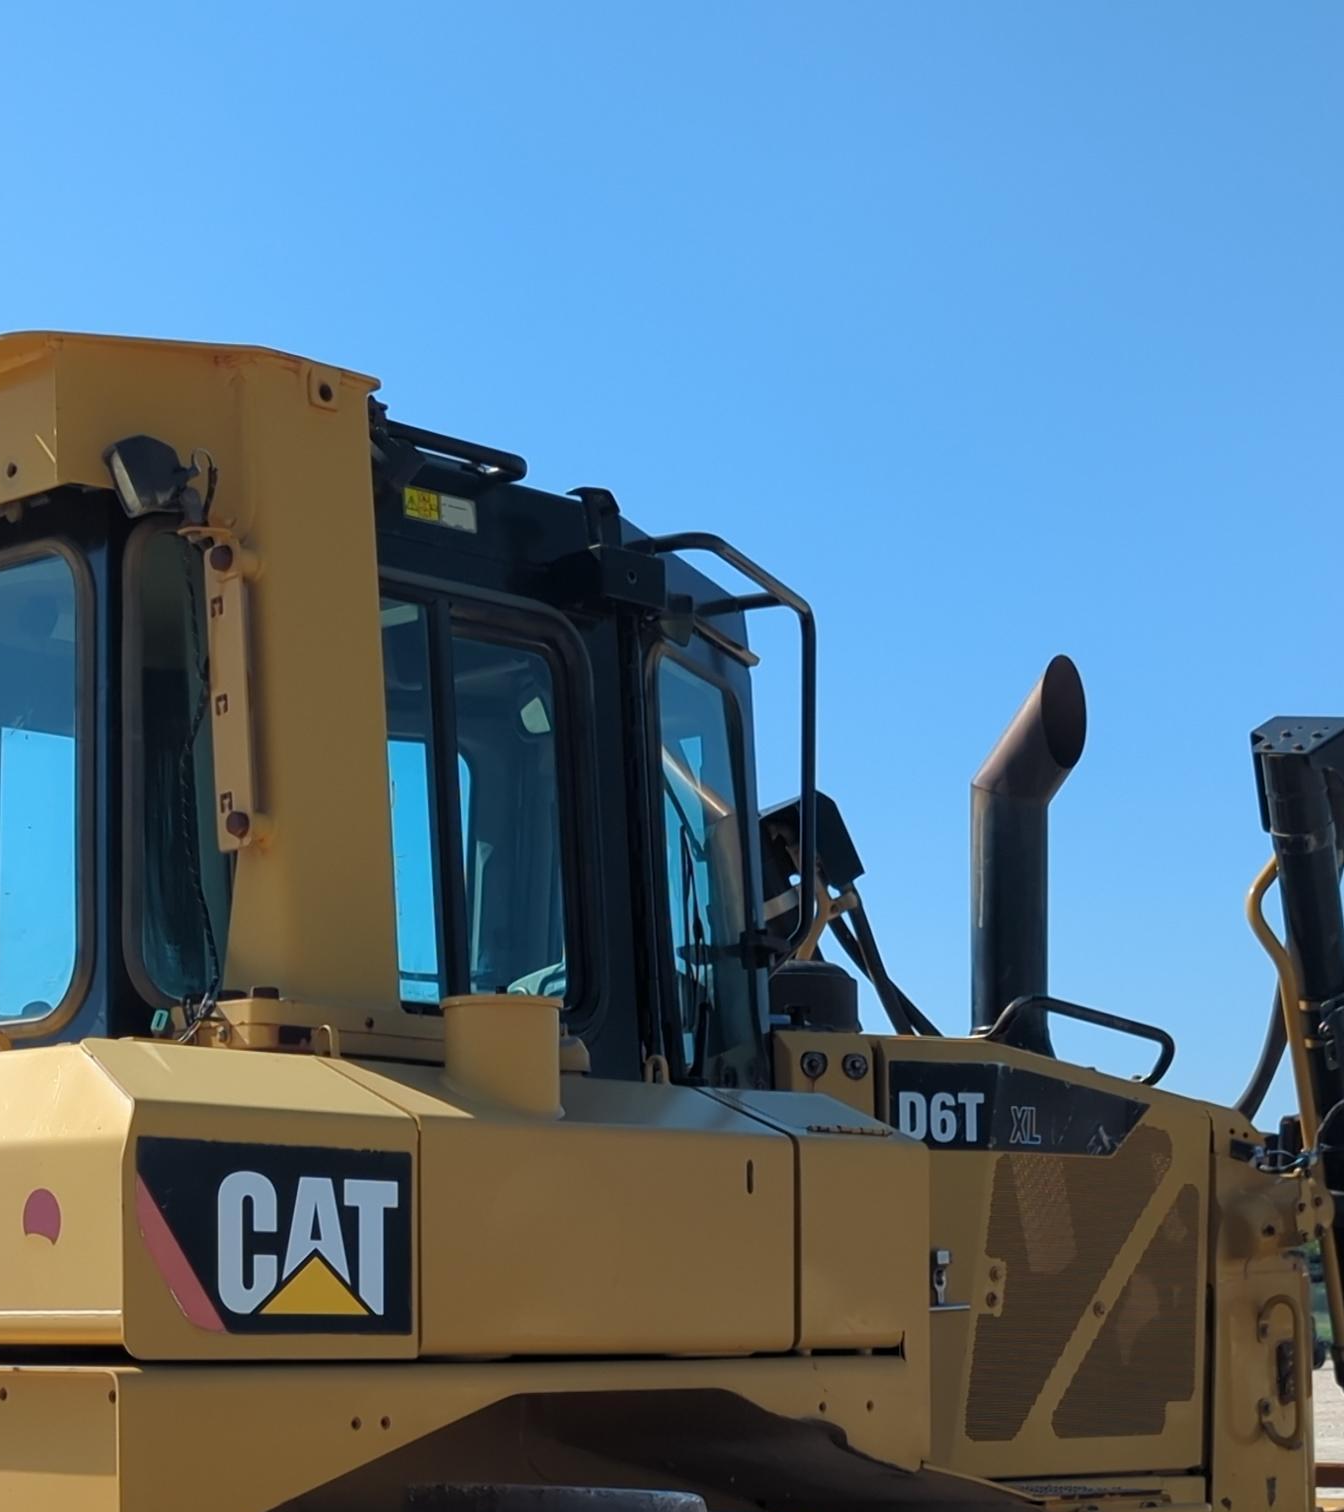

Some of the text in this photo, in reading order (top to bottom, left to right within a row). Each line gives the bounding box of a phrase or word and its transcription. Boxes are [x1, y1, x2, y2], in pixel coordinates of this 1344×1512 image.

[899, 1092, 1042, 1145] D6T XL
[217, 1170, 399, 1316] CAT
